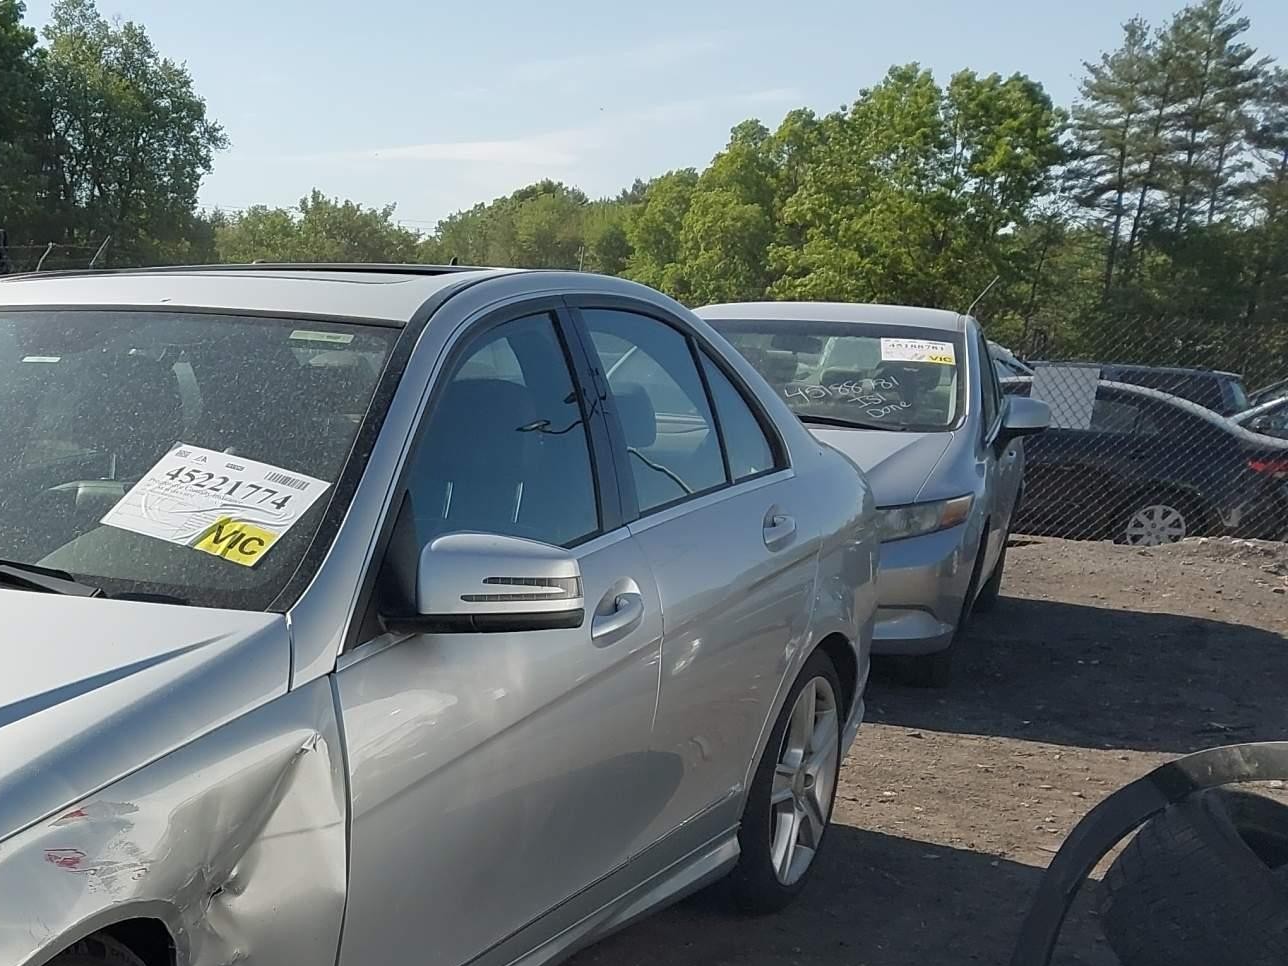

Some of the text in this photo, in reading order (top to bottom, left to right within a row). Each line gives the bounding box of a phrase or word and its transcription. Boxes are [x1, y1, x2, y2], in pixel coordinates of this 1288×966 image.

[929, 355, 953, 363] VIC
[866, 400, 912, 417] Done
[165, 465, 293, 511] 45221774
[212, 524, 265, 556] VIC
